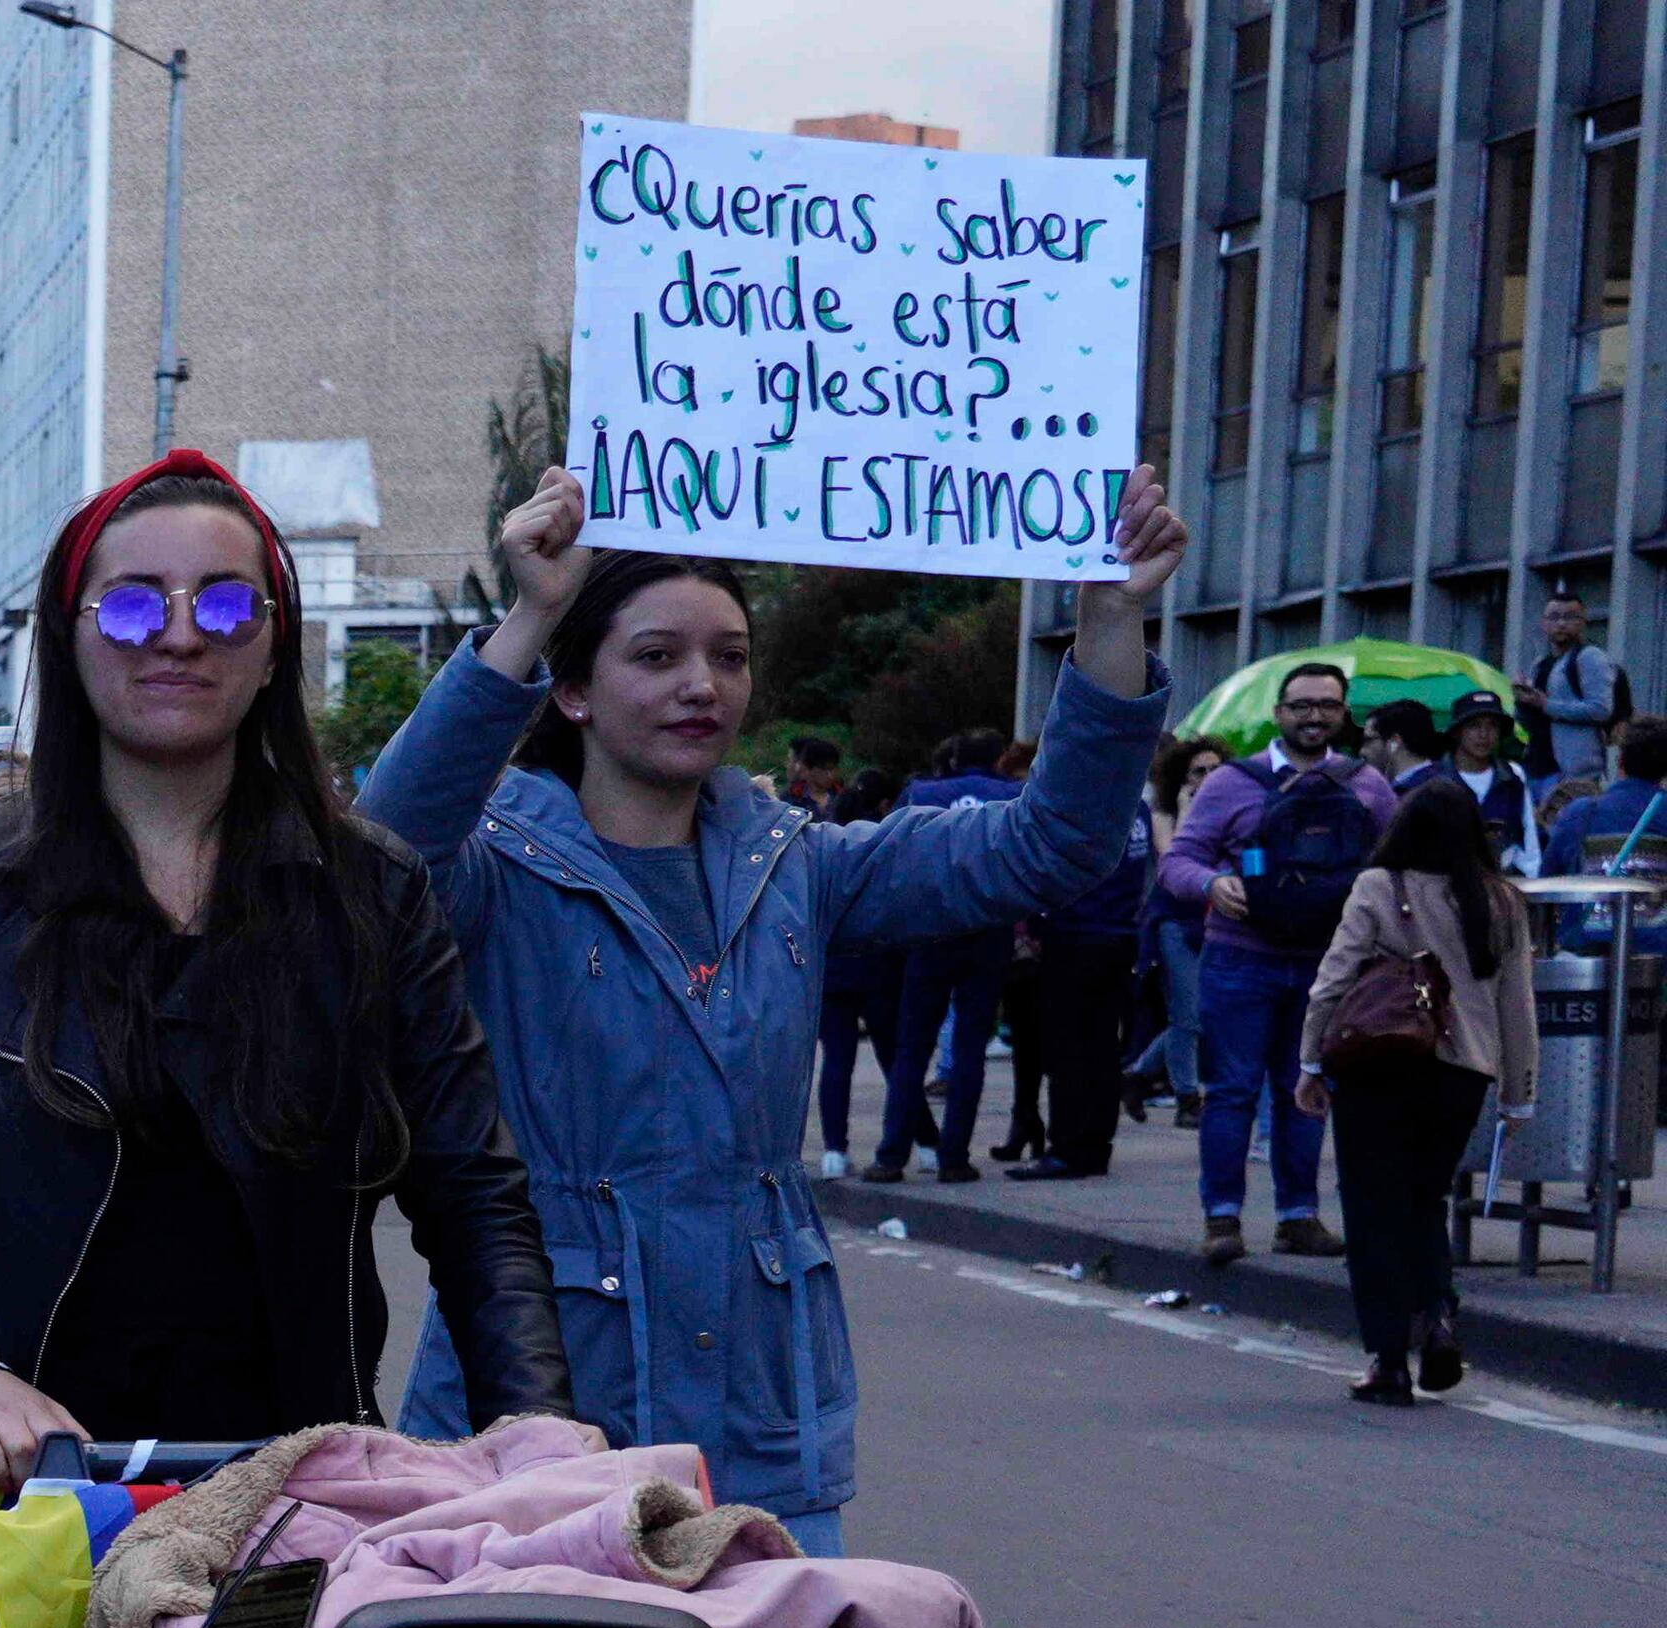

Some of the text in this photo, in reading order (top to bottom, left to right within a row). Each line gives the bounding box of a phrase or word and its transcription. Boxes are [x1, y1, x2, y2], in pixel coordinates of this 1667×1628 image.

[660, 250, 1030, 354] dónde está
[634, 311, 699, 411] la
